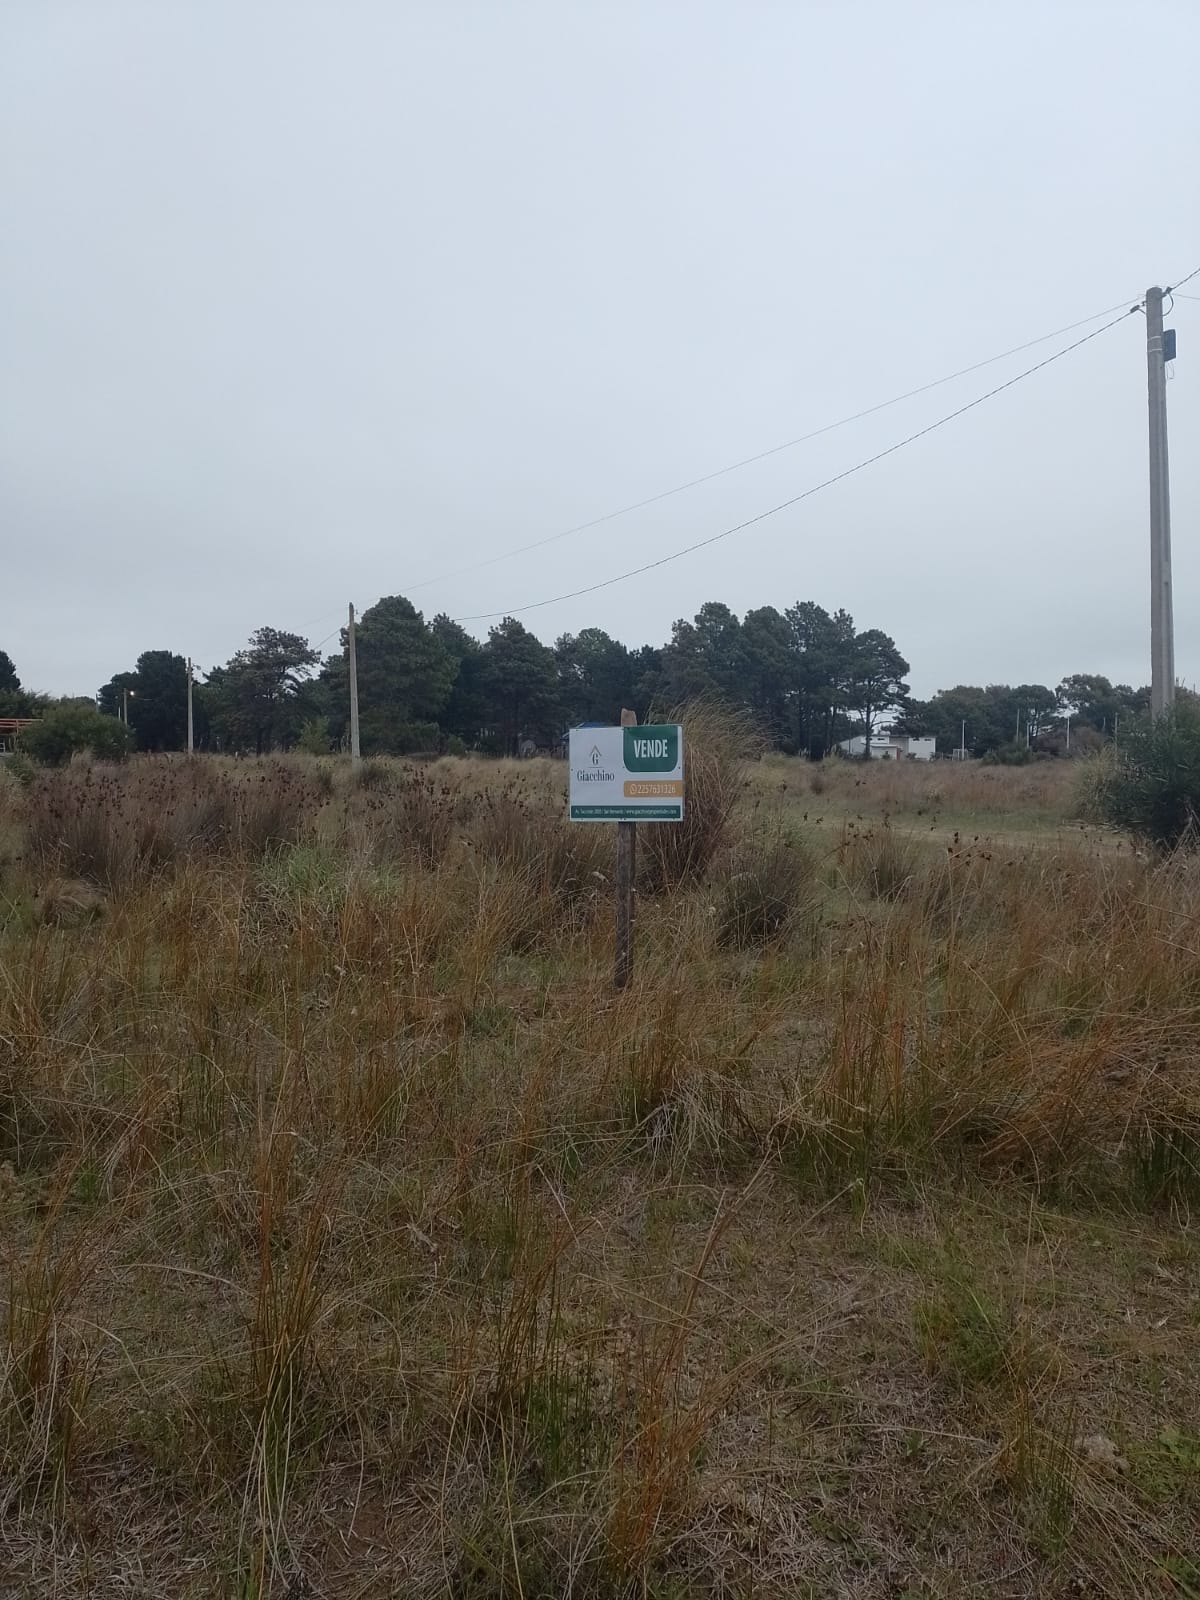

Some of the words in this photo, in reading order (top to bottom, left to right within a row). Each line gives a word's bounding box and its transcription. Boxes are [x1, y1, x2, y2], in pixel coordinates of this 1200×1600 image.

[633, 739, 669, 758] VENDE
[592, 752, 599, 765] G
[576, 769, 615, 782] Giacchino
